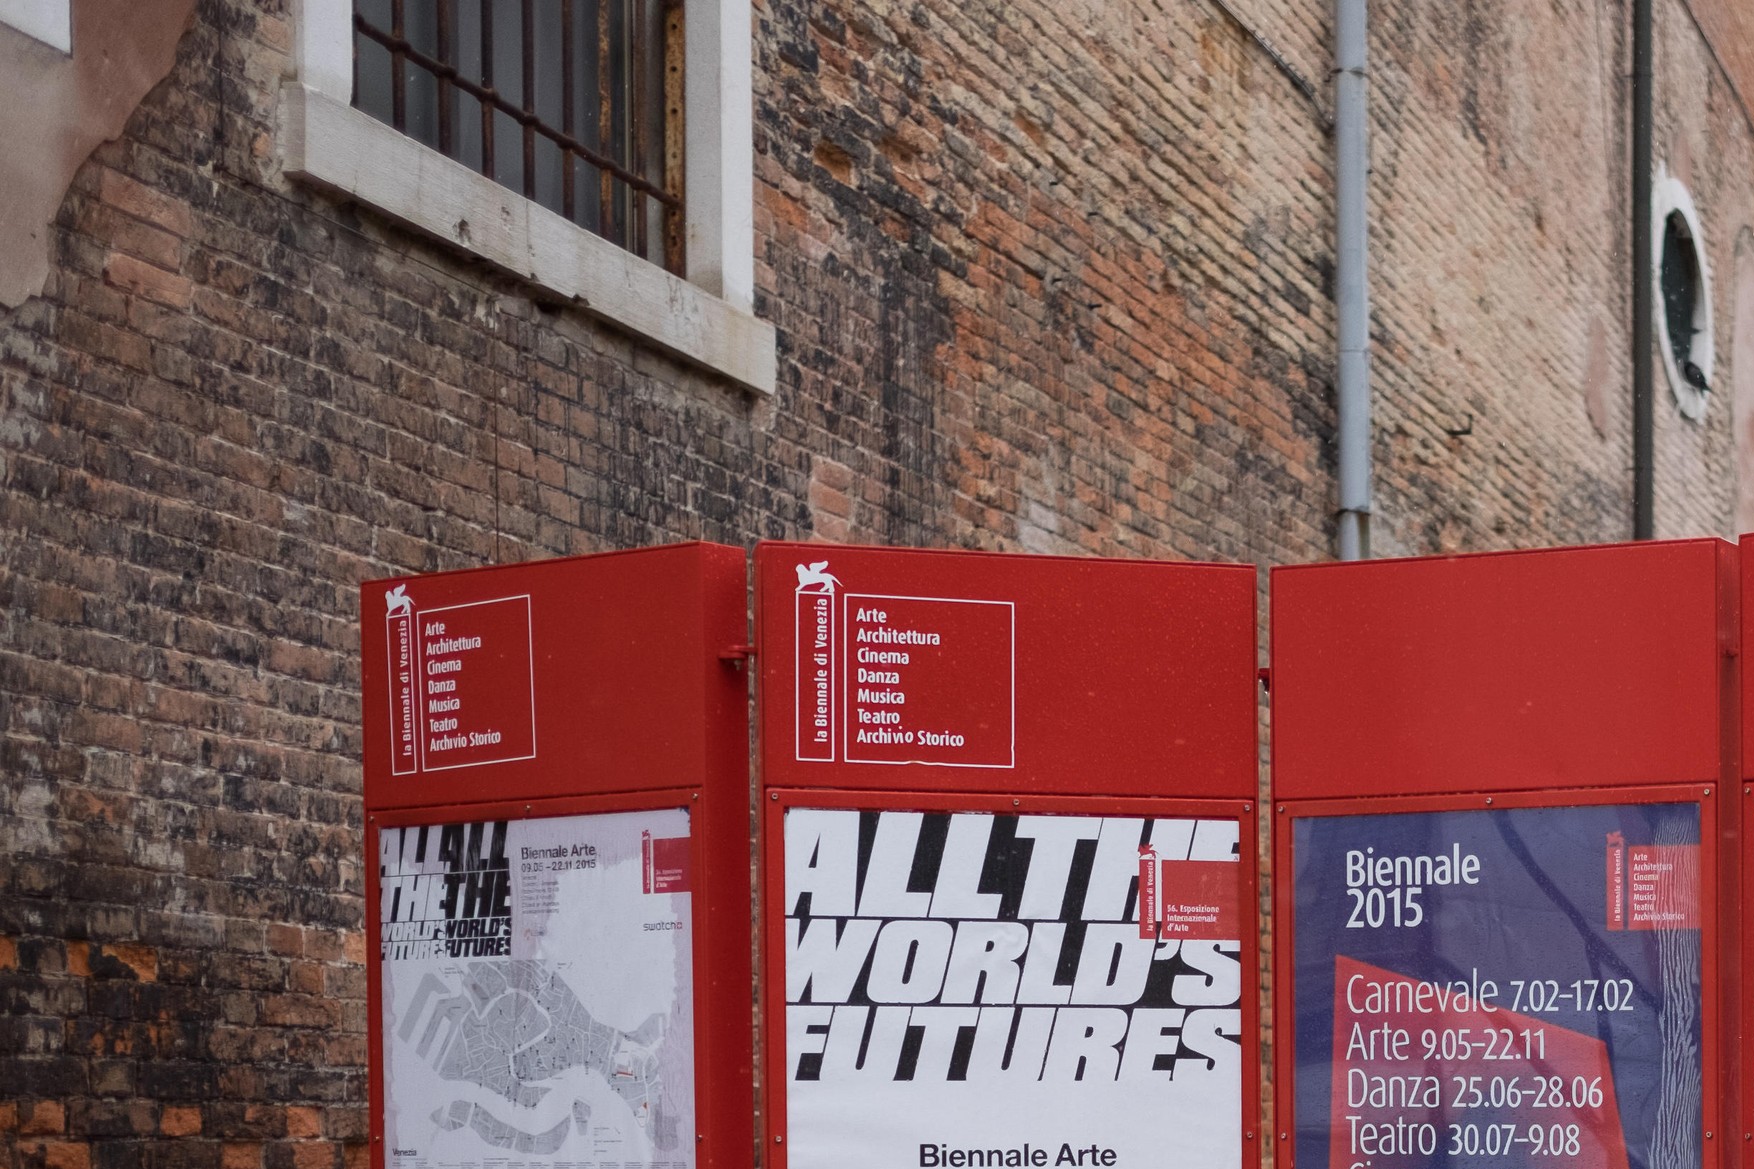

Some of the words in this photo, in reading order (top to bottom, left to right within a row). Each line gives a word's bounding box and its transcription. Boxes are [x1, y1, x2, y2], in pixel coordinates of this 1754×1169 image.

[814, 598, 828, 648] Venezia
[856, 607, 887, 623] Arte
[425, 622, 446, 636] Arte
[856, 626, 940, 645] Architettura
[398, 620, 408, 667] Venezia
[426, 636, 481, 656] Architettura
[814, 653, 828, 666] di
[857, 647, 910, 665] Cinema
[427, 659, 461, 675] Cinema
[857, 668, 900, 684] Danza
[400, 672, 409, 683] di
[428, 679, 456, 694] Danza
[429, 696, 460, 713] Musica
[814, 669, 828, 727] Biennale
[857, 688, 905, 704] Musica
[401, 687, 412, 741] Biennale
[857, 708, 900, 724] Teatro
[429, 717, 457, 732] Teatro
[430, 733, 467, 752] Archivio
[469, 729, 501, 747] Storico
[814, 730, 828, 742] la
[856, 725, 914, 744] Archivio
[917, 730, 965, 747] Storico
[403, 745, 412, 756] la
[439, 820, 509, 873] ALL
[521, 844, 568, 860] Biennale
[571, 843, 597, 857] Arte
[521, 861, 543, 873] 09.05
[552, 859, 596, 871] 22.11.2015
[1346, 842, 1481, 887] Biennale
[1180, 904, 1220, 915] Esposizione
[1345, 887, 1423, 928] 2015
[643, 921, 676, 932] swatch
[785, 918, 1241, 1006] WORLD'S
[1346, 967, 1500, 1014] Carnevale
[785, 1004, 1241, 1082] FUTURES
[1345, 1021, 1411, 1061] Arte
[1345, 1068, 1441, 1109] Danza
[1345, 1115, 1438, 1156] Teatro
[919, 1143, 1048, 1168] Biennale
[1055, 1143, 1117, 1167] Arte
